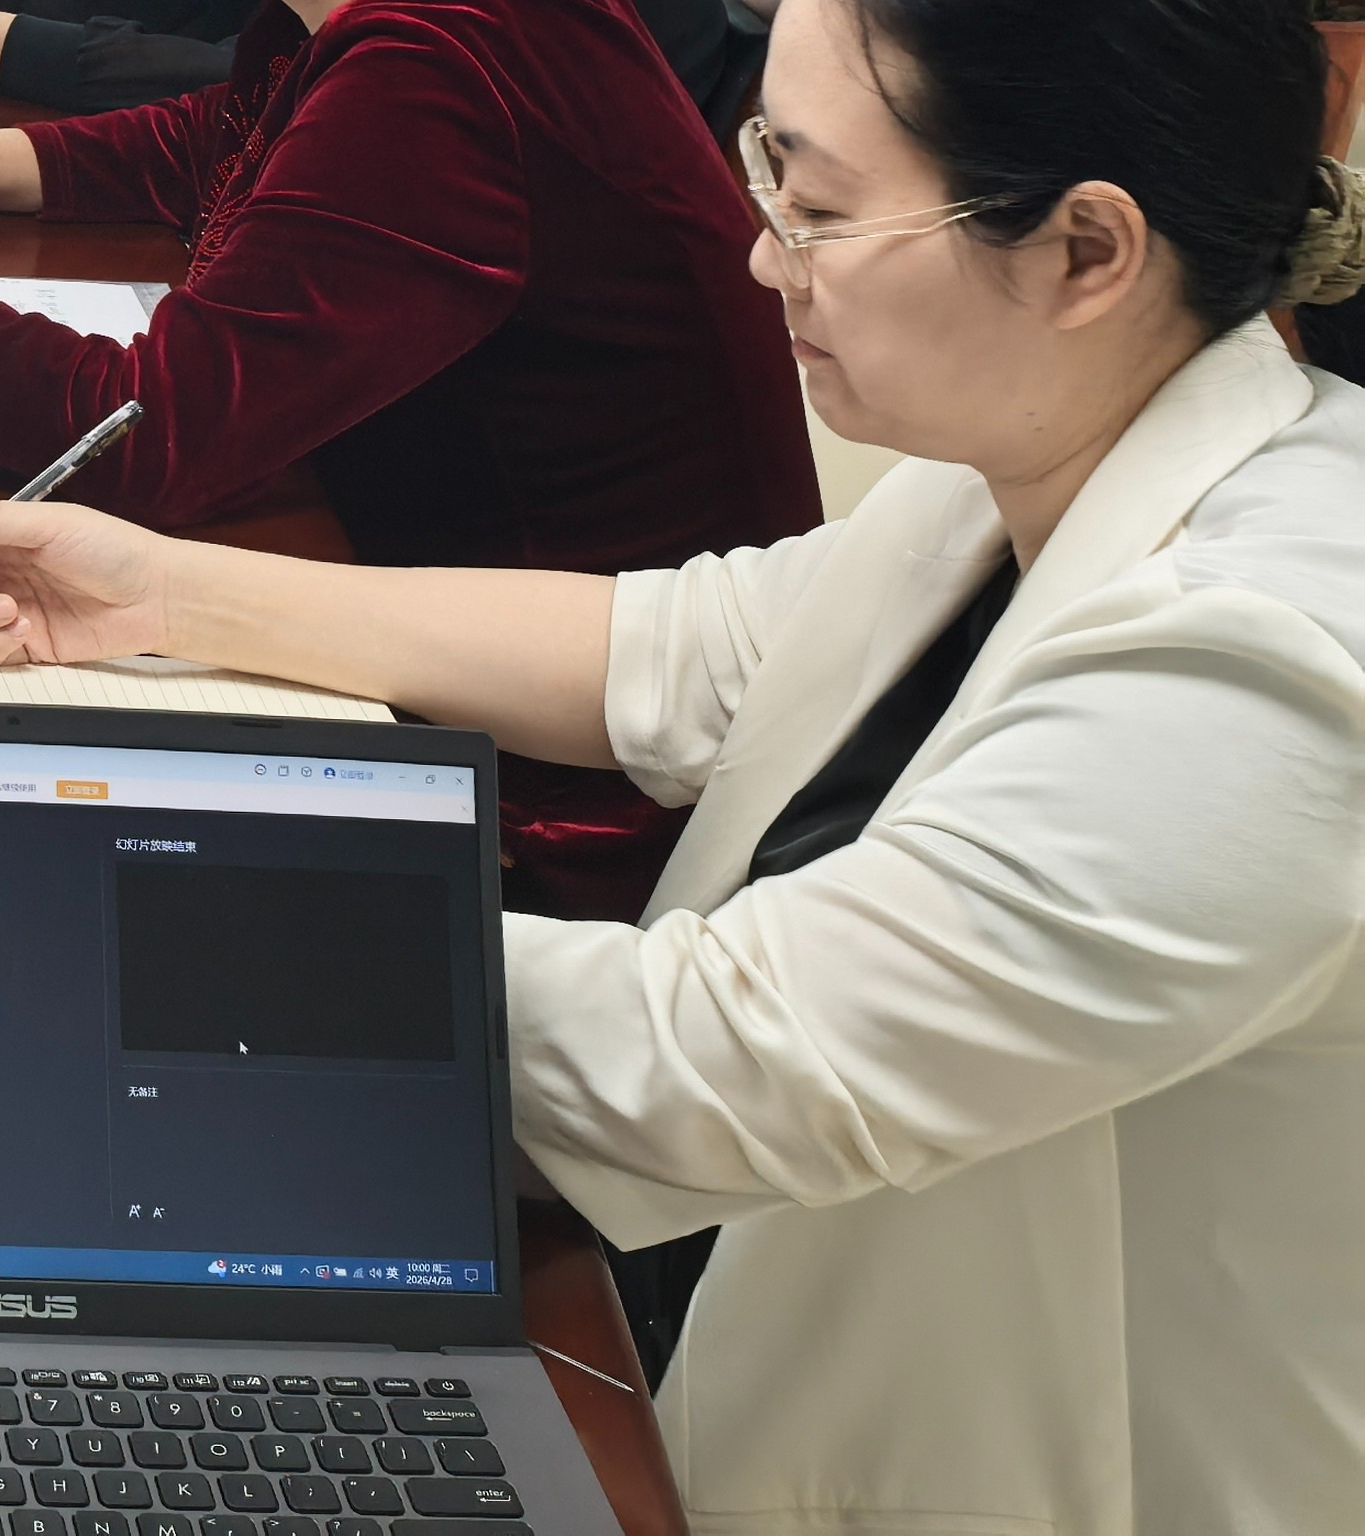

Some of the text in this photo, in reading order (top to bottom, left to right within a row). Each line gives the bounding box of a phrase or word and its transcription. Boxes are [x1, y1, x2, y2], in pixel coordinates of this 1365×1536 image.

[115, 838, 197, 853] 幻灯片放映结束
[128, 1085, 159, 1098] 无备注
[385, 1265, 400, 1280] 英
[407, 1262, 431, 1273] 10:00
[406, 1274, 453, 1286] 2026/4/28
[47, 1400, 58, 1411] 7
[110, 1401, 120, 1413] 8
[169, 1403, 180, 1415] 9
[231, 1406, 242, 1417] 0
[27, 1438, 39, 1450] Y
[89, 1440, 101, 1452] U
[154, 1442, 159, 1454] I
[210, 1443, 227, 1456] O
[275, 1445, 285, 1457] P
[53, 1480, 66, 1492] H
[119, 1481, 126, 1494] J
[178, 1483, 191, 1496] K
[243, 1484, 253, 1497] L
[475, 1488, 504, 1498] enter
[33, 1521, 44, 1533] B
[95, 1522, 109, 1535] N
[158, 1524, 177, 1536] M
